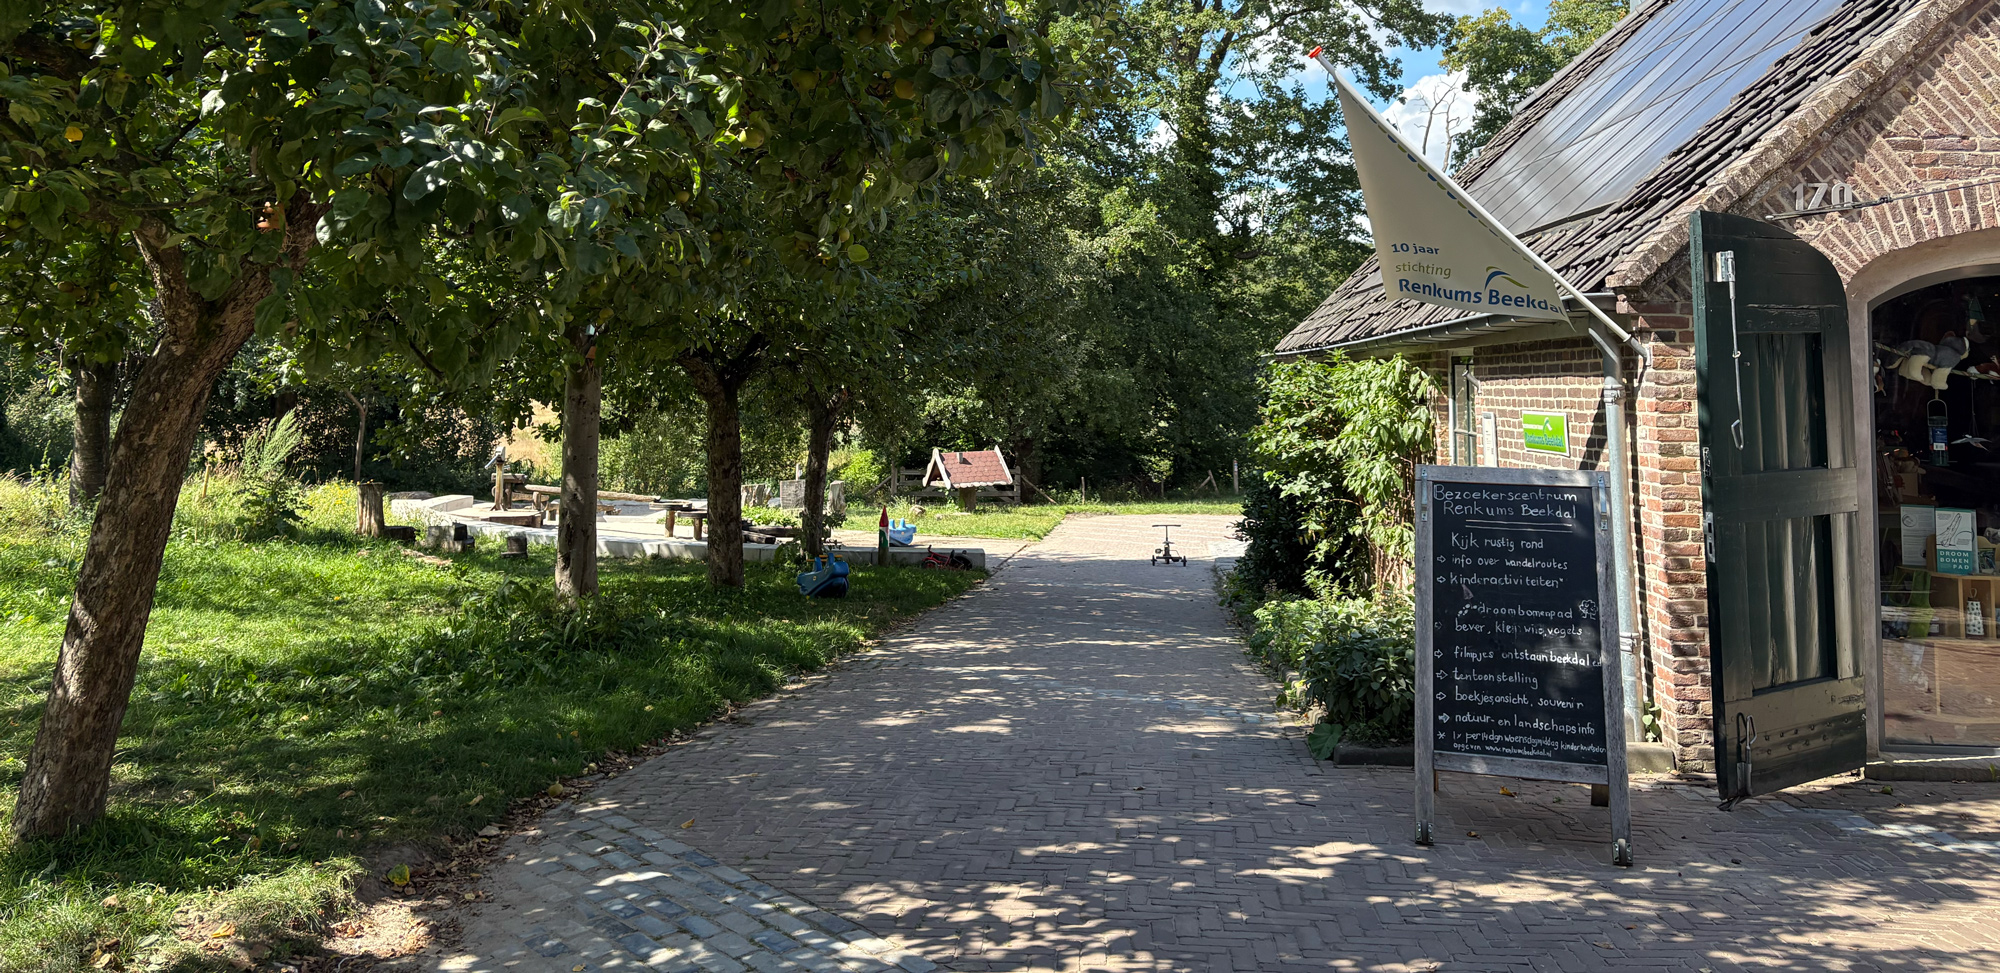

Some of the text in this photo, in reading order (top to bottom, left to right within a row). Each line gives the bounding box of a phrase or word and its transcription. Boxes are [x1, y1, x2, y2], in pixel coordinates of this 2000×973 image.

[1391, 242, 1440, 255] 10 jaar
[1395, 261, 1452, 279] stichting
[1398, 278, 1566, 317] Renkums Beekdal
[1433, 484, 1578, 502] Bezoekerscentrum
[1443, 501, 1576, 519] Renkums Beekdal
[1451, 532, 1544, 552] Kijk rustig rond
[1451, 554, 1568, 570] info over wandelroutes
[1477, 602, 1573, 619] droombomenpad
[1453, 646, 1494, 663] filmpjes
[1452, 666, 1539, 689] tentoonstelling
[1537, 697, 1584, 710] souvenir
[1455, 711, 1495, 724] natuur-
[1497, 717, 1511, 727] en
